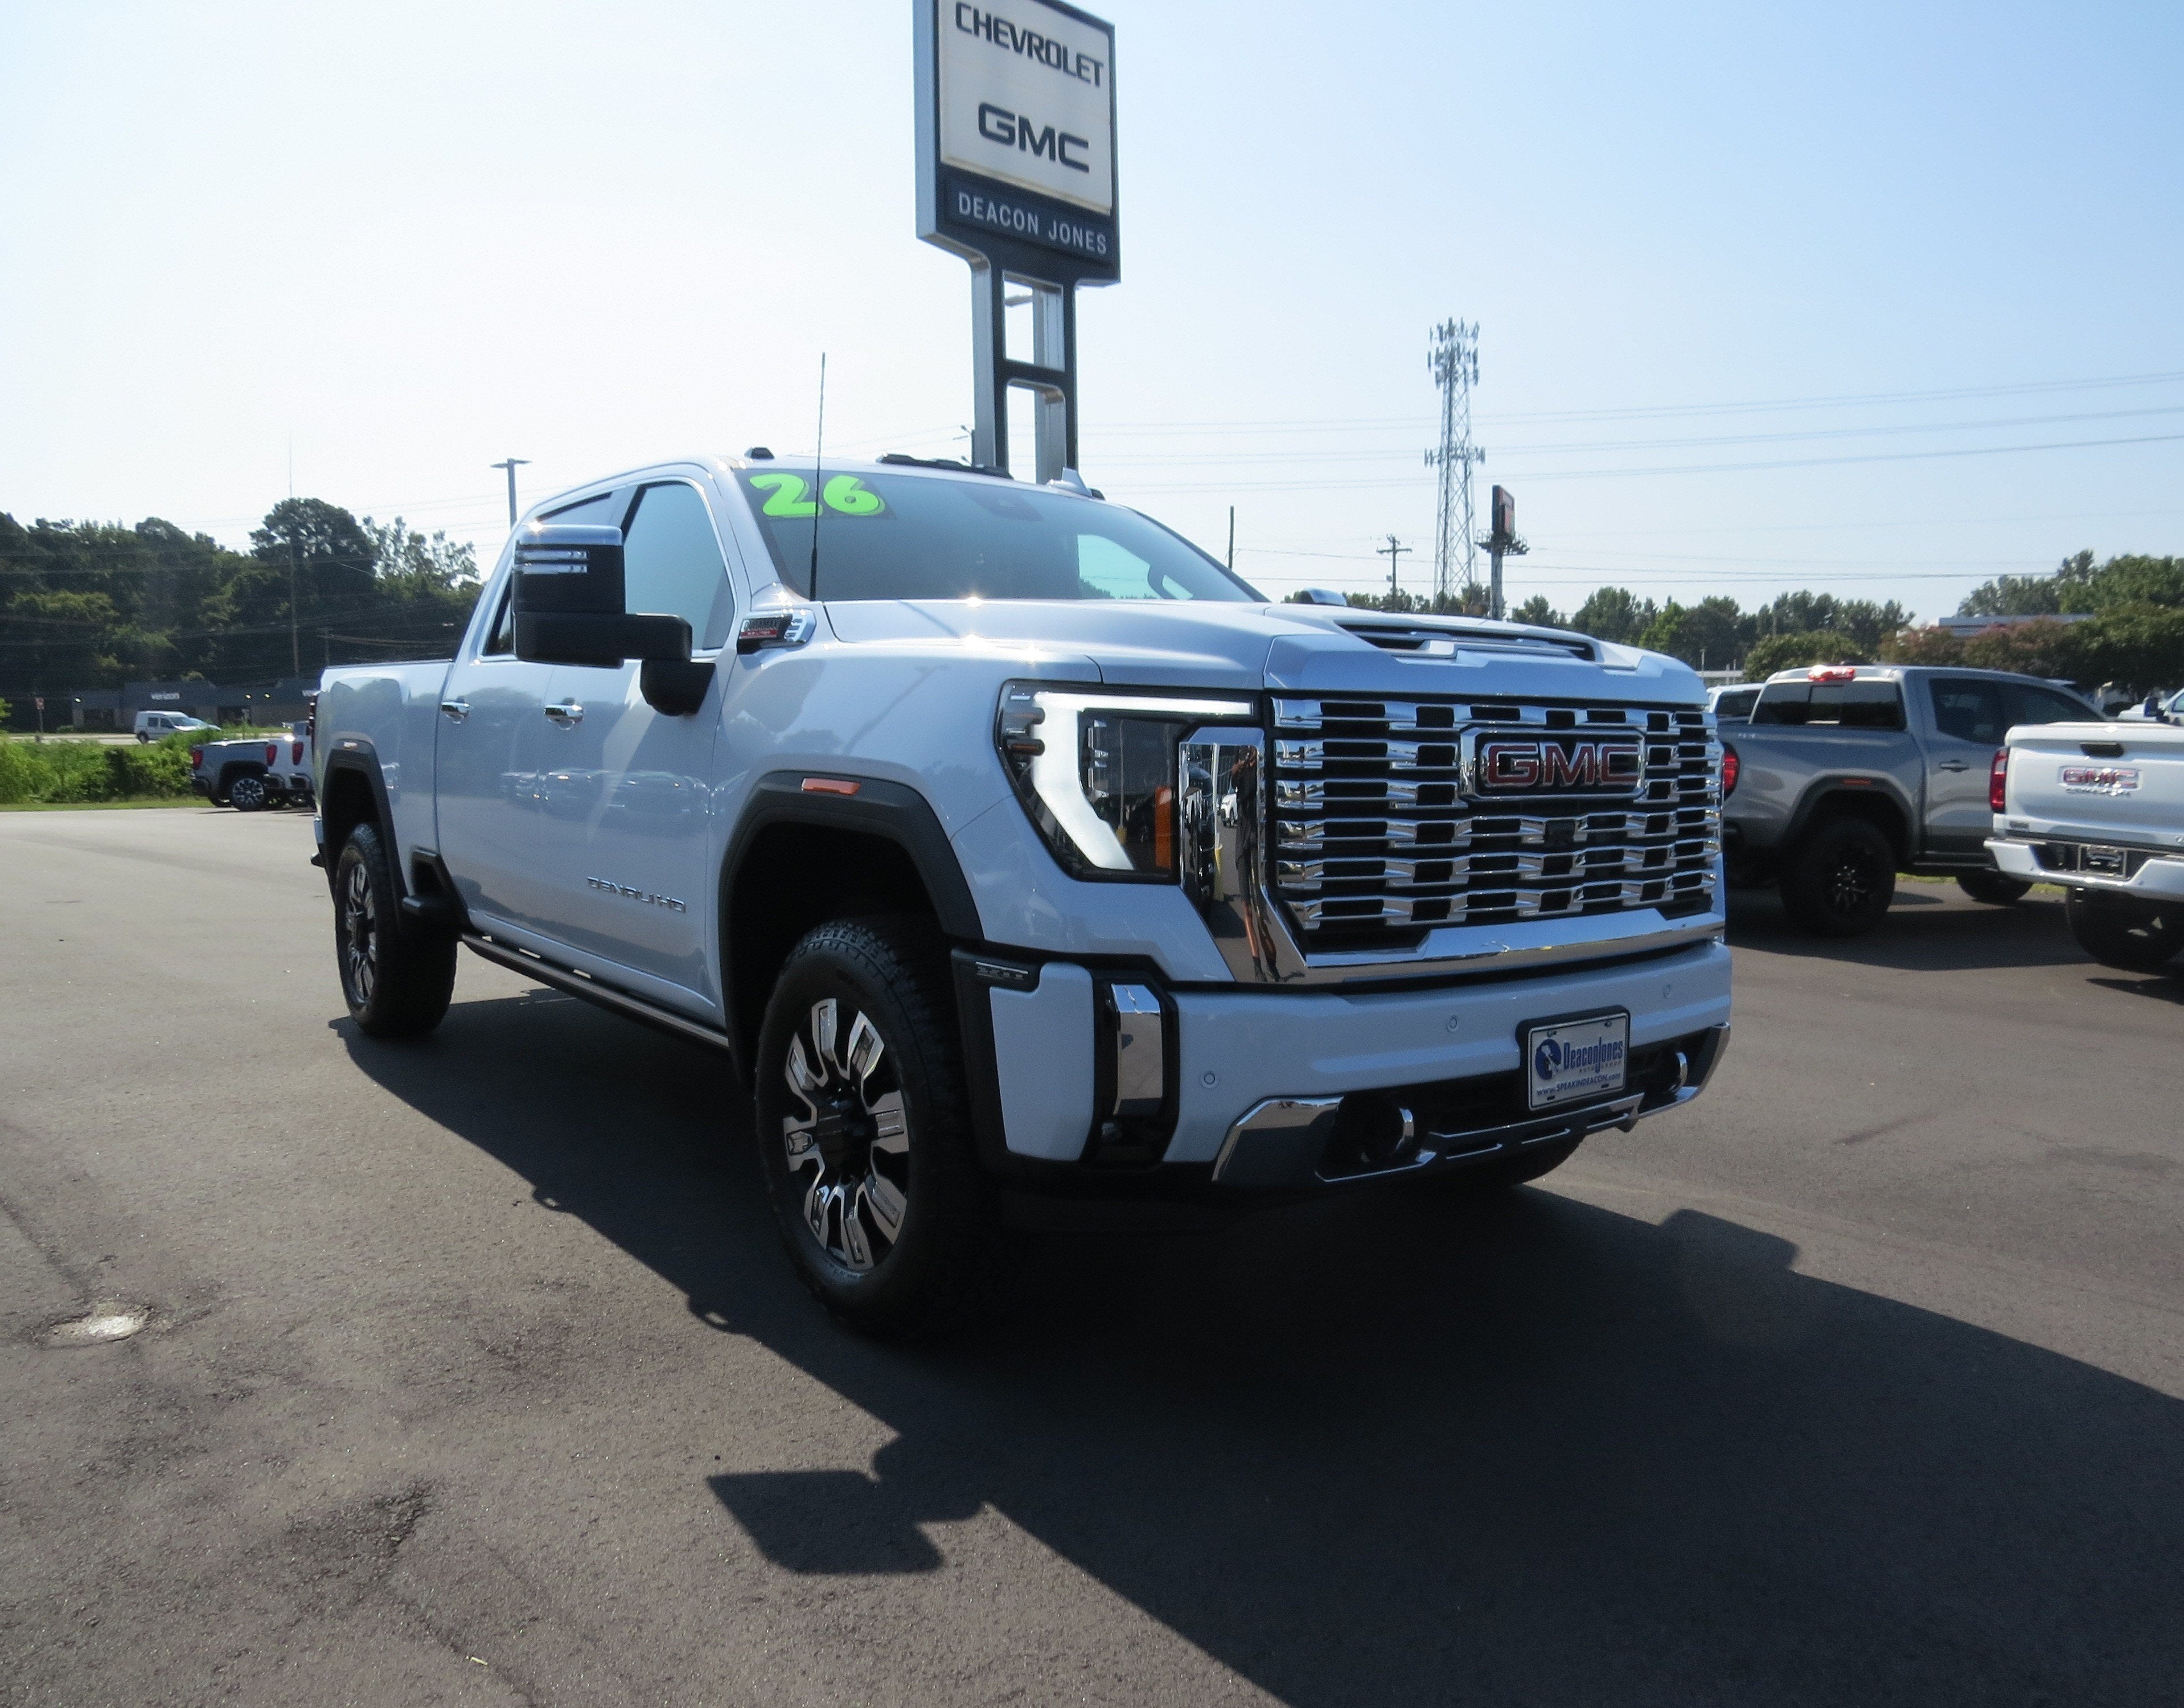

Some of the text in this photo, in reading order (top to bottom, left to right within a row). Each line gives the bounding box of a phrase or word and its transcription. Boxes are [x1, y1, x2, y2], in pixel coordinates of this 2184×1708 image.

[955, 2, 1104, 88] CHEVROLET
[978, 101, 1090, 174] GMC
[958, 191, 1107, 254] DEACON JONES
[749, 473, 885, 518] 26
[1481, 742, 1640, 787] GMC
[2063, 769, 2138, 789] GMC
